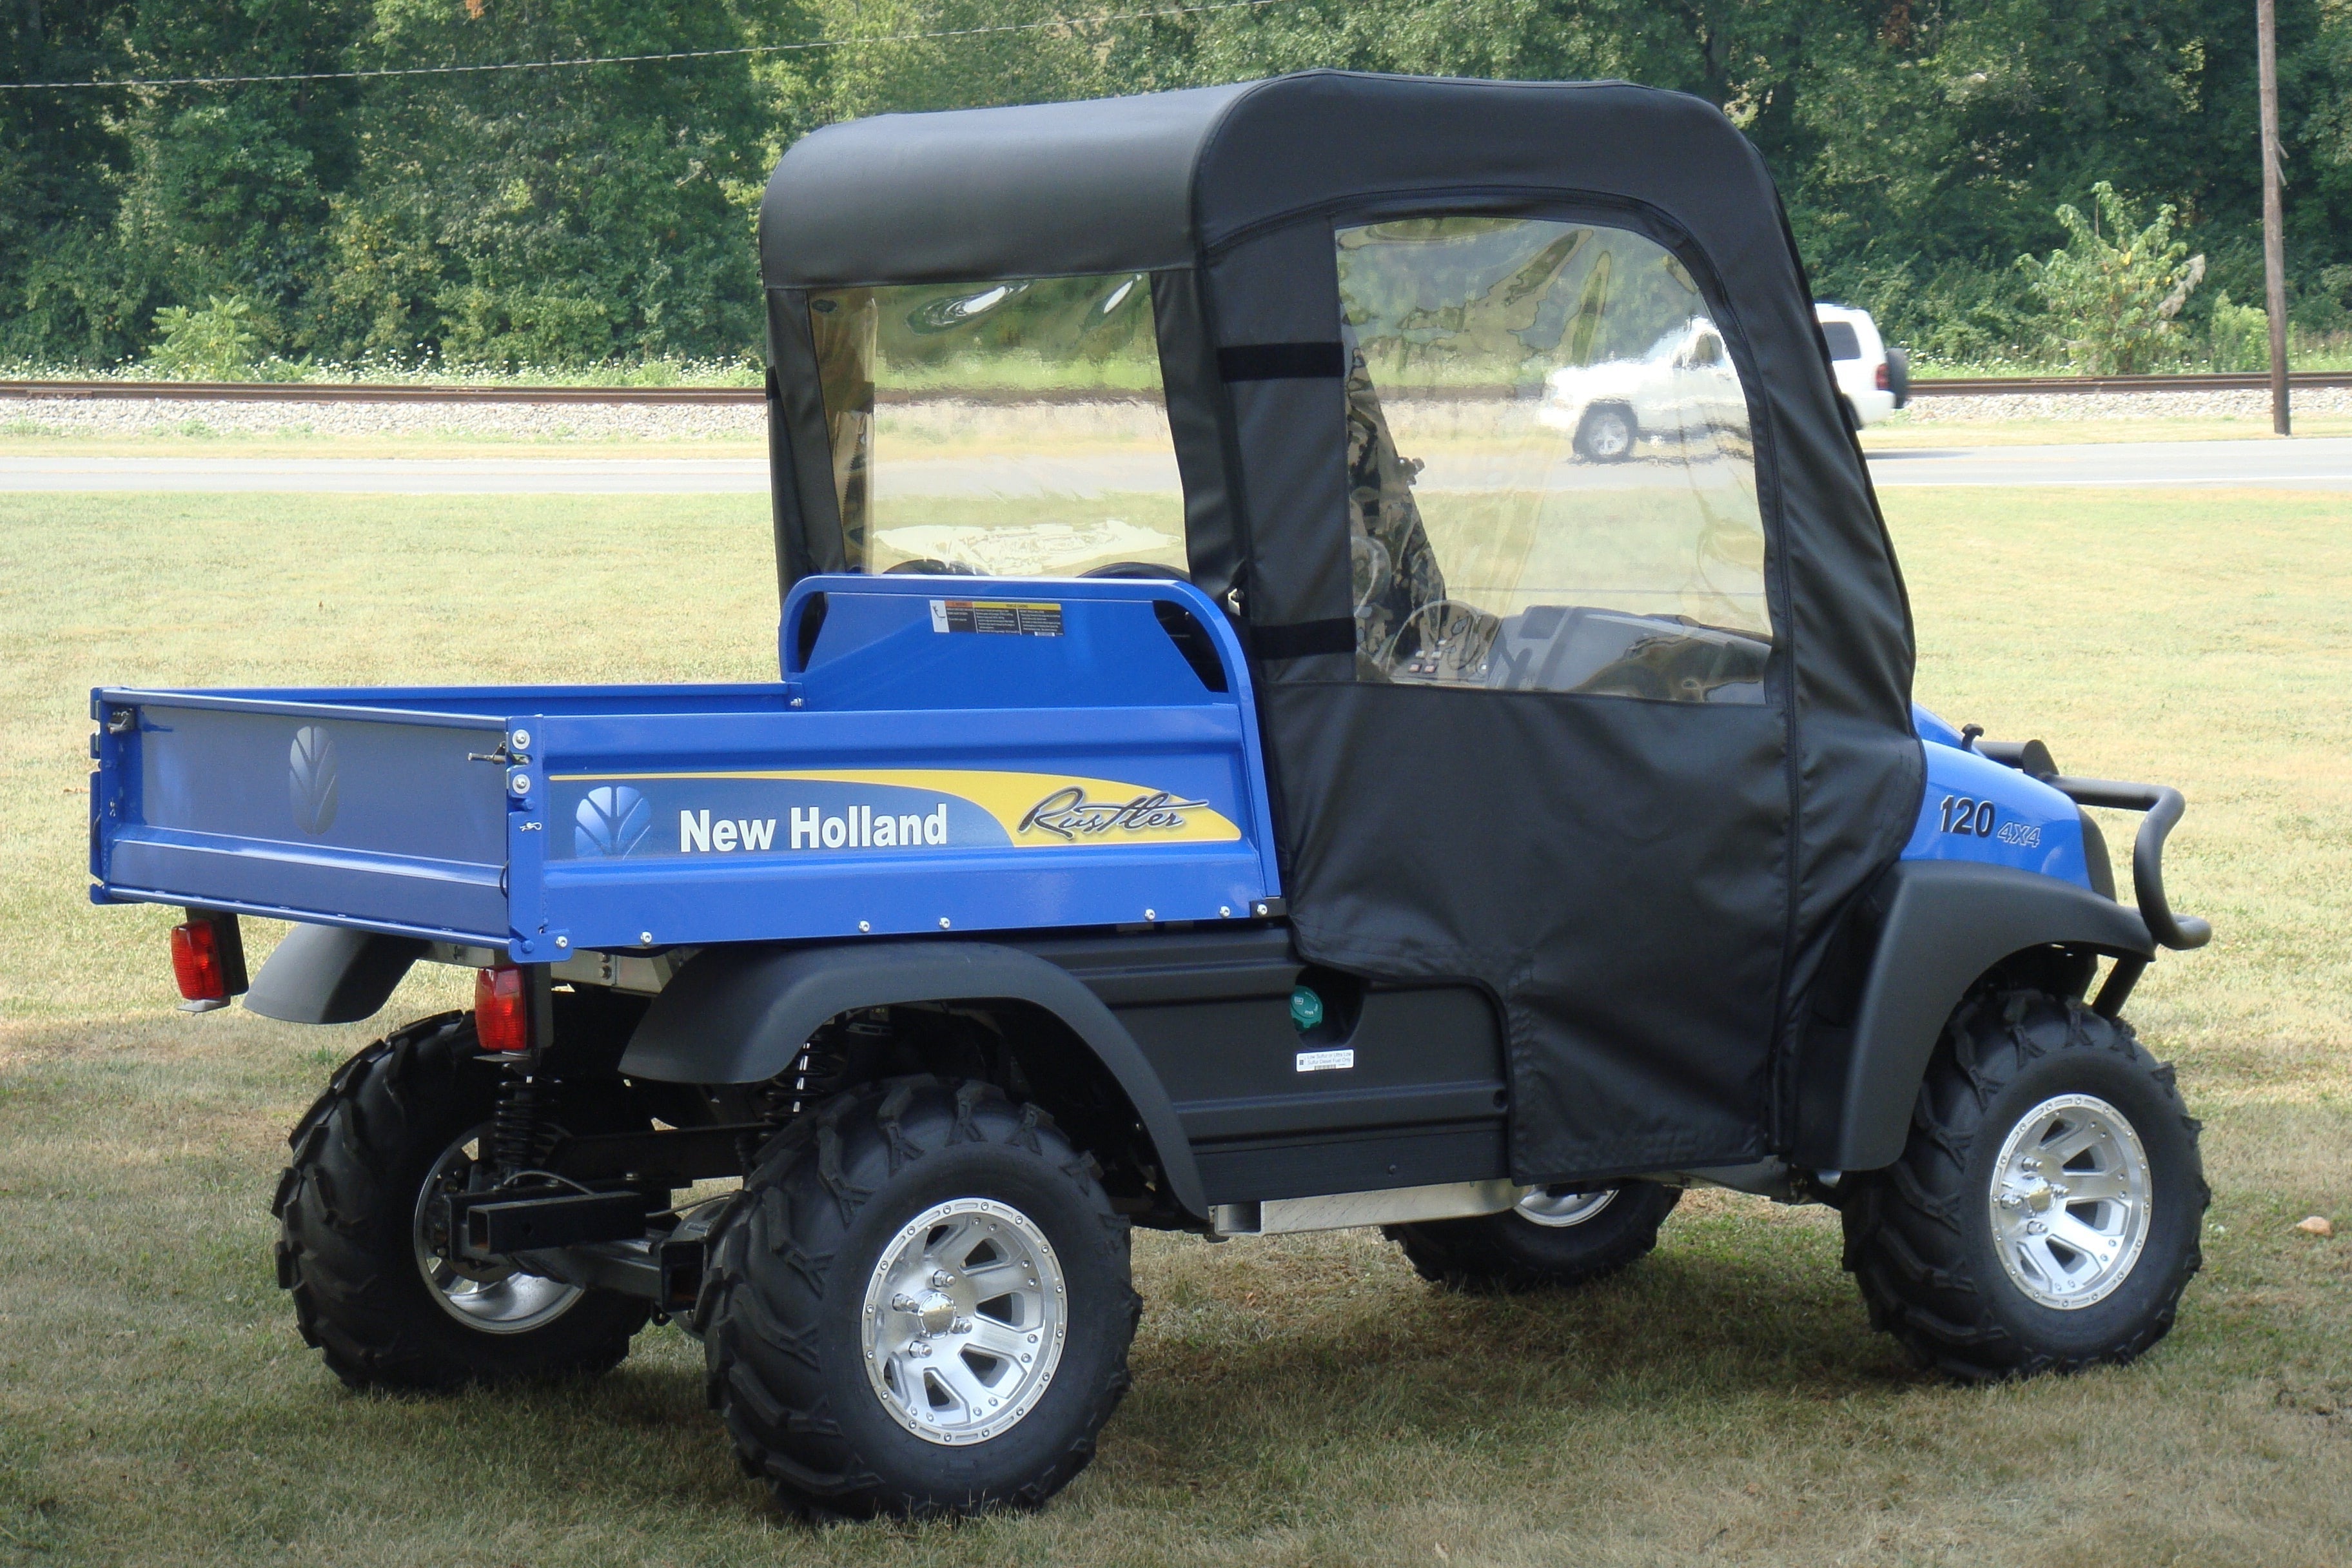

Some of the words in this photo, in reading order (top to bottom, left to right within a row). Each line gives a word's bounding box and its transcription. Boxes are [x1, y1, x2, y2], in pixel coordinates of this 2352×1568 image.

[680, 809, 777, 852] New
[790, 803, 947, 849] Holland
[1017, 785, 1210, 840] Rustler
[1939, 794, 1995, 838] 120
